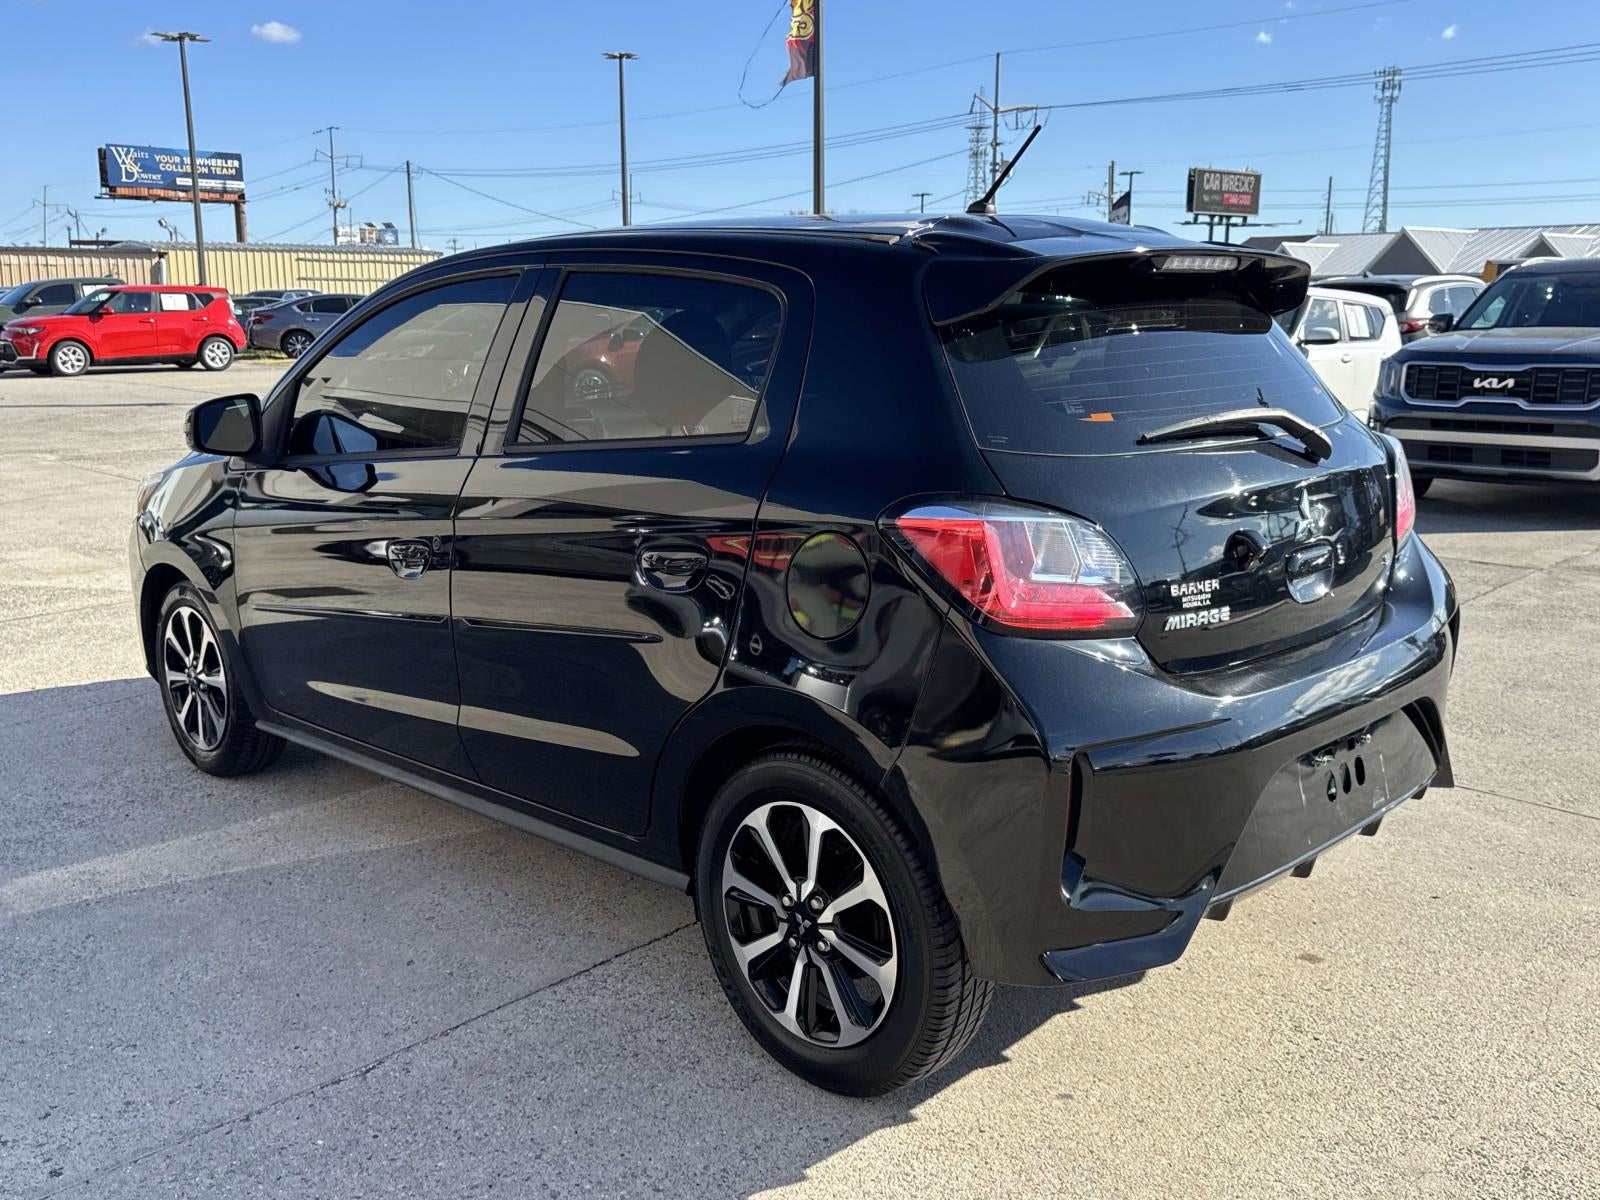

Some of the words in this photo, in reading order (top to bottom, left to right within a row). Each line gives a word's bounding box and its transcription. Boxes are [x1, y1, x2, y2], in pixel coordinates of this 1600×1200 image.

[154, 154, 180, 164] YOUR
[159, 163, 209, 174] COLLISON
[211, 166, 236, 176] TEAM
[1203, 172, 1221, 191] CAR
[1473, 377, 1515, 389] KIA
[1170, 579, 1220, 597] BARKER
[1182, 593, 1212, 602] MITSUBISHI
[1164, 606, 1231, 632] MIRAGE
